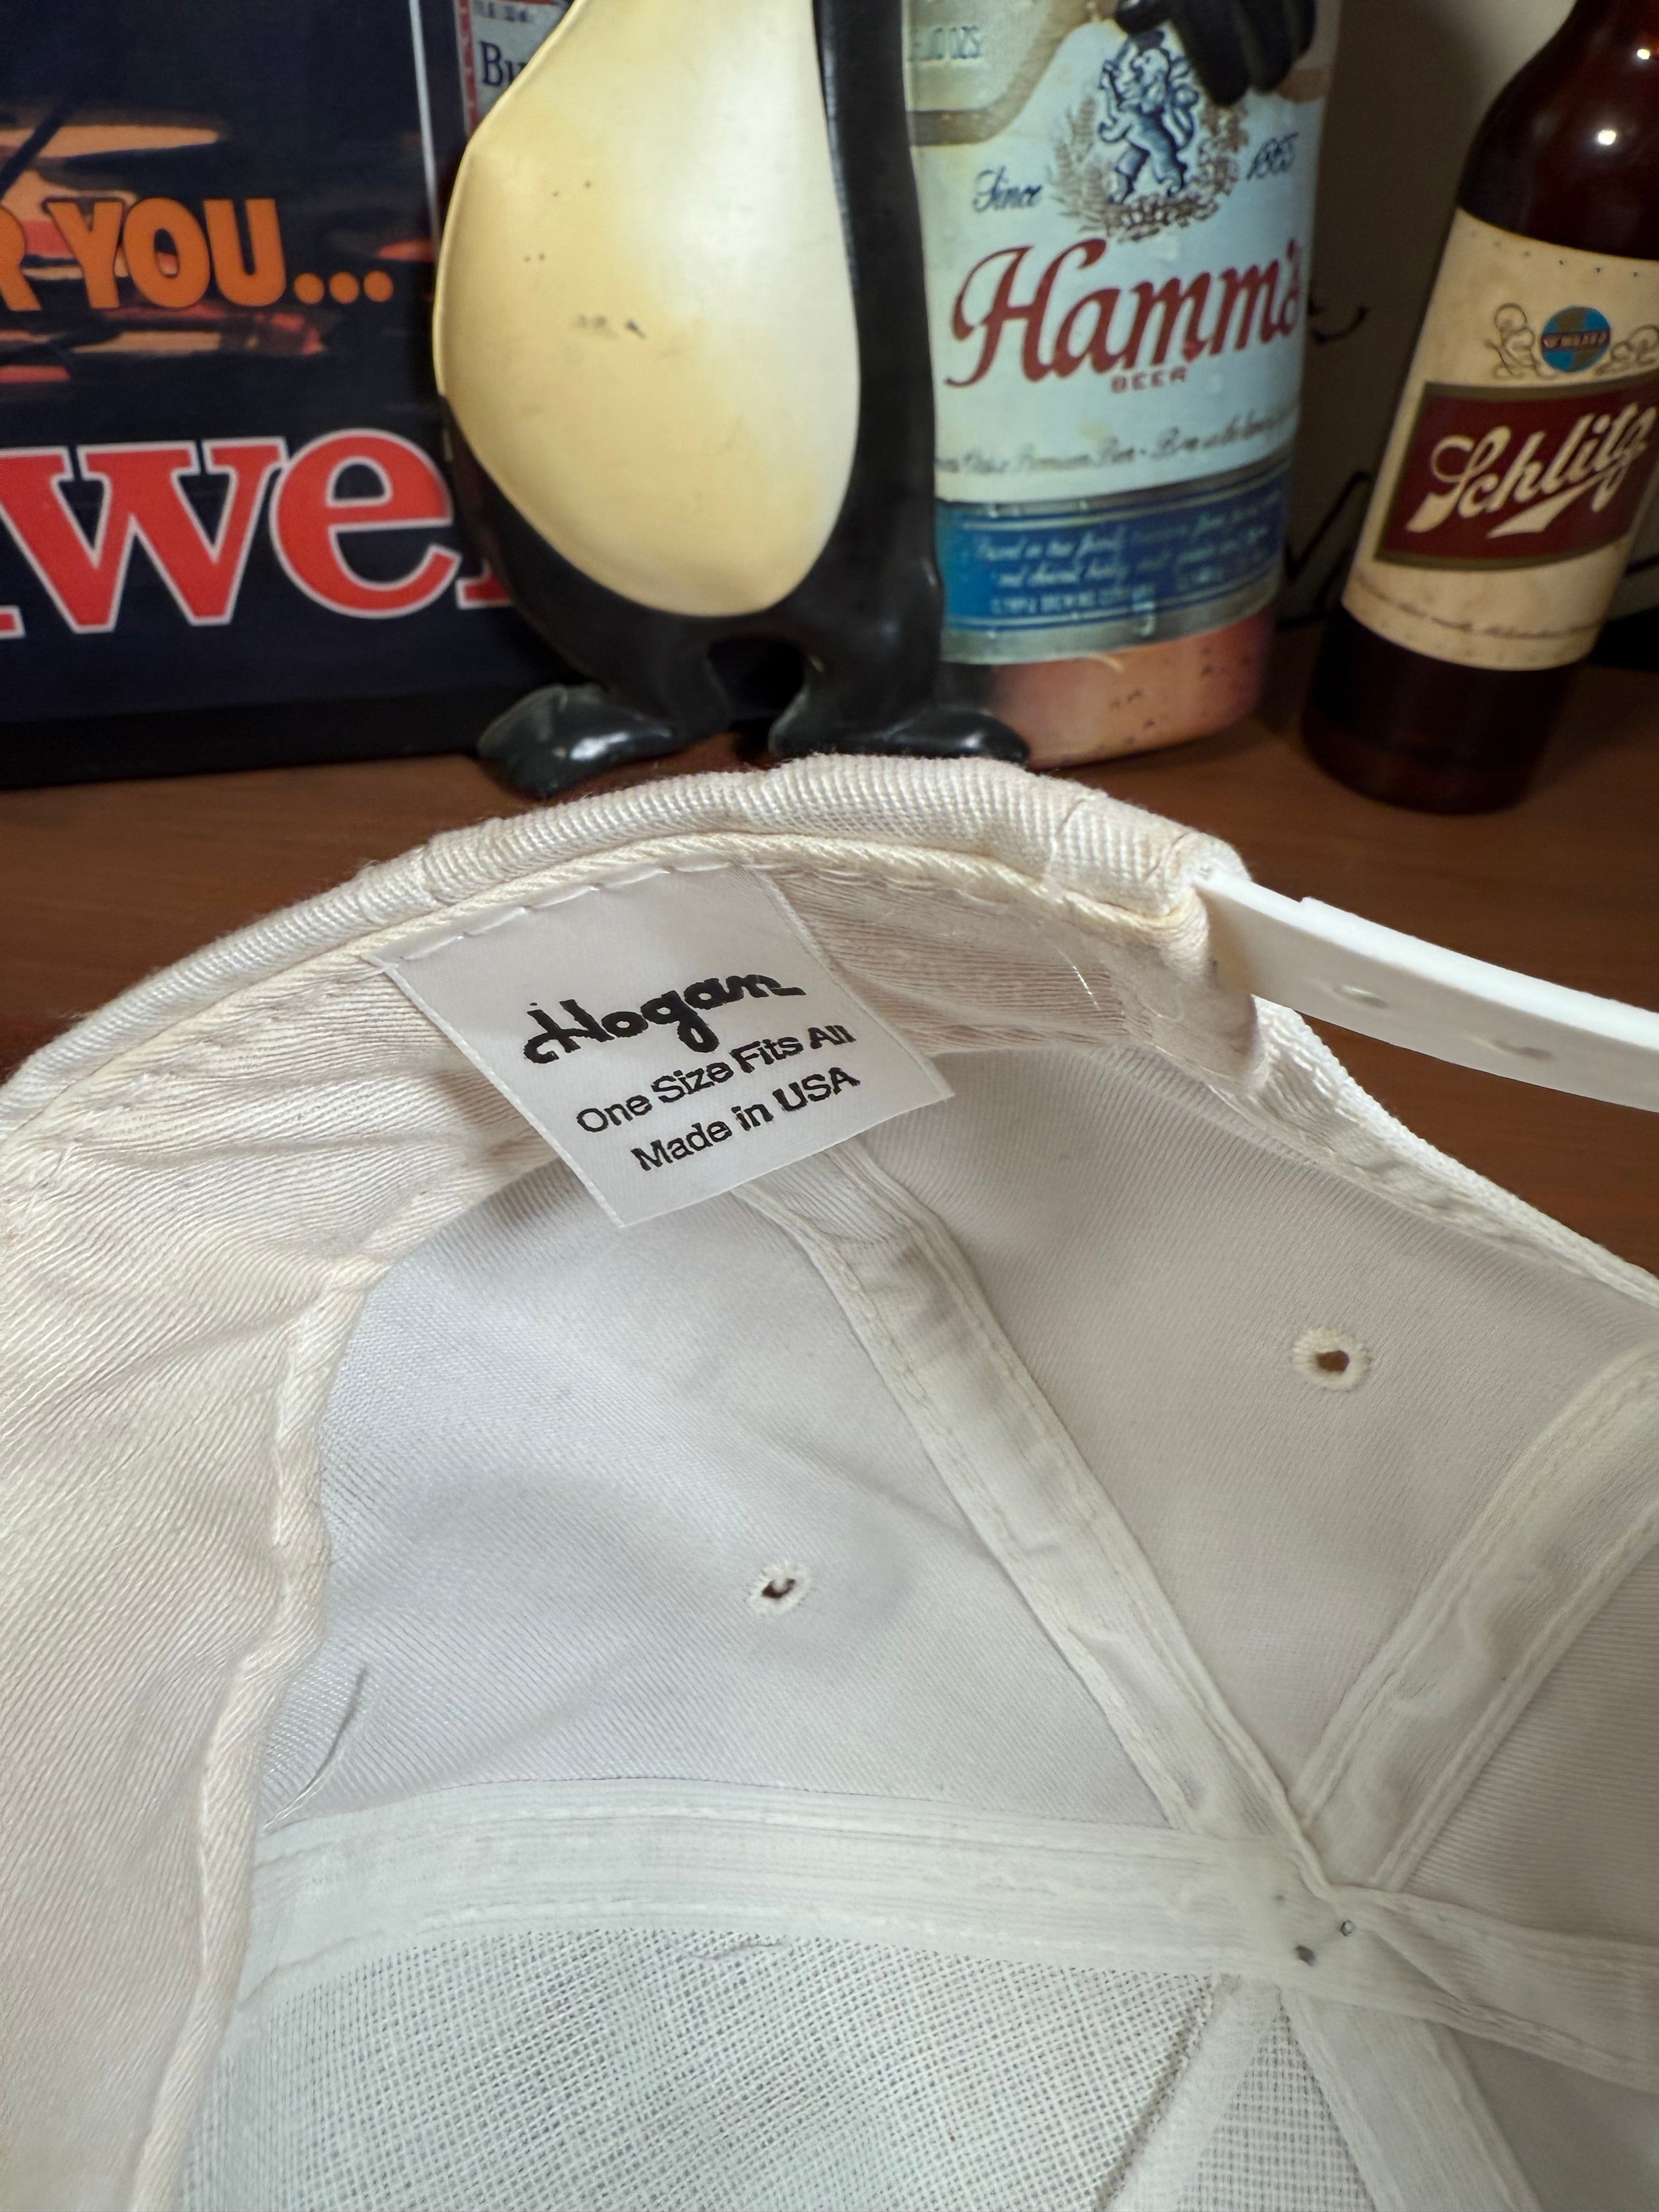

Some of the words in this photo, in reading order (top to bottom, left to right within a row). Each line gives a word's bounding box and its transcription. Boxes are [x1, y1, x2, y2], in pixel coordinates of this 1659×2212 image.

[945, 238, 1302, 387] Hamm's
[1110, 366, 1188, 394] BEER
[523, 973, 807, 1064] Hogan
[576, 1094, 653, 1133] One
[651, 1060, 734, 1104] Size
[730, 1035, 804, 1074] Fits
[809, 1024, 856, 1049] All
[631, 1119, 733, 1172] Made
[735, 1103, 775, 1132] in
[772, 1066, 861, 1113] USA
